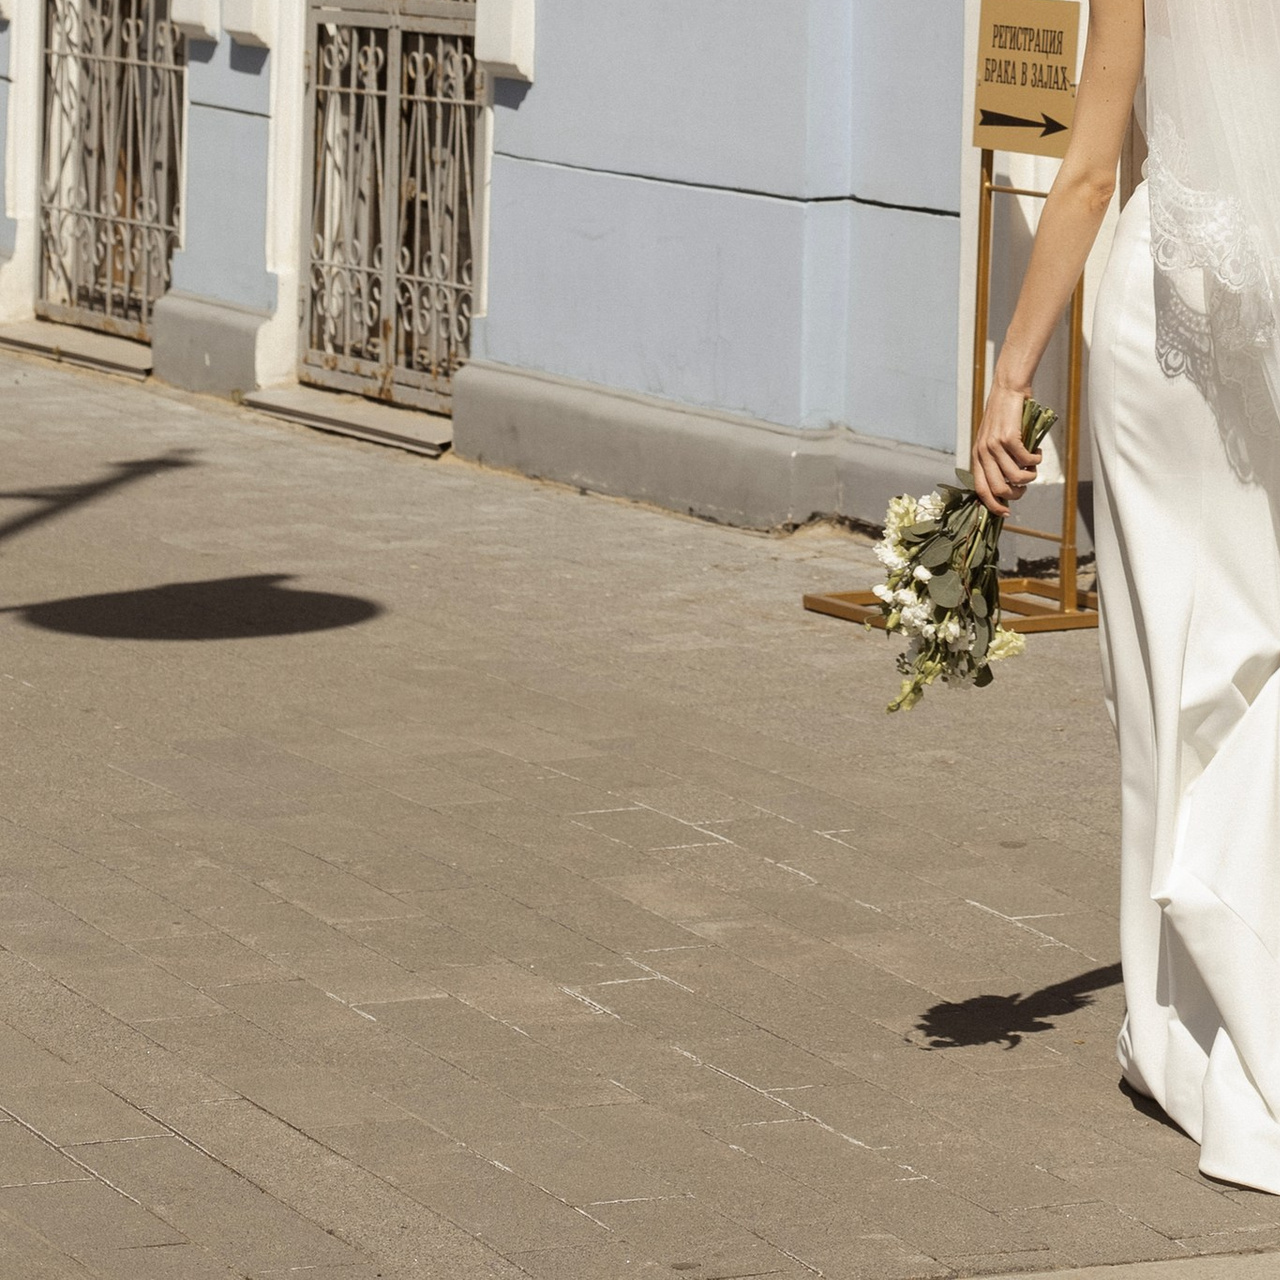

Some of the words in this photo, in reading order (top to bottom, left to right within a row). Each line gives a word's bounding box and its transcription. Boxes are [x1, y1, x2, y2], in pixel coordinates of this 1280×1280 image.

[992, 24, 1063, 60] РЕГИСТРАЦИЯ
[984, 58, 1017, 85] БРАКА
[1021, 62, 1028, 86] В
[1031, 63, 1068, 91] ЗАЛАХ
